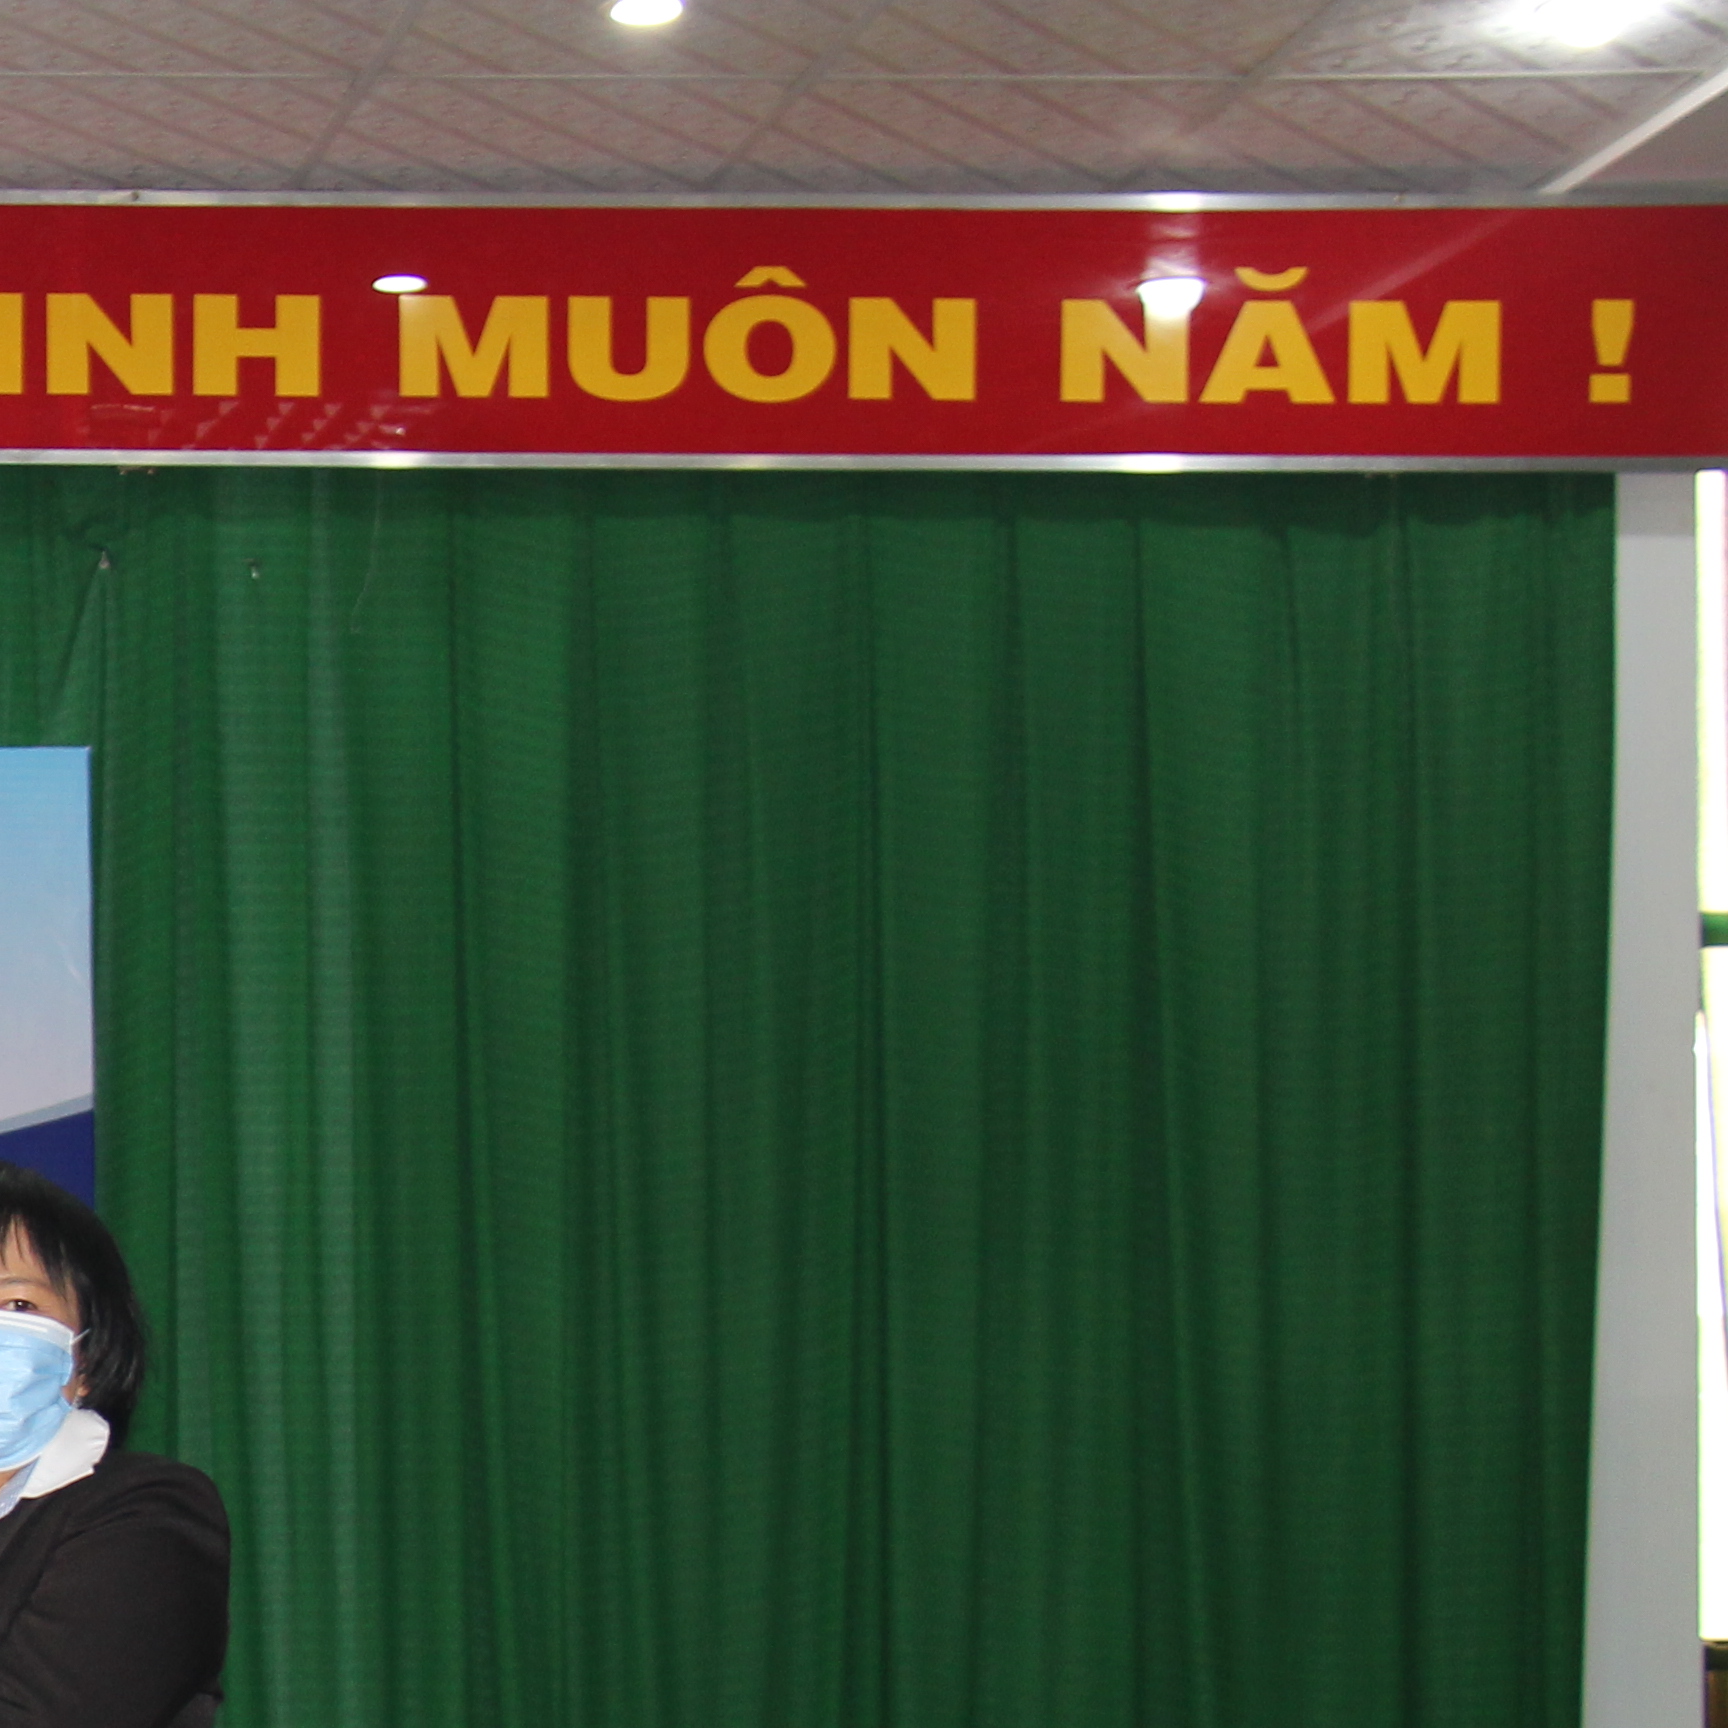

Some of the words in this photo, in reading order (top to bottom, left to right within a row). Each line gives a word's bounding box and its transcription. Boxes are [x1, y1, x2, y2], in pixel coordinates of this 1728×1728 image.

[398, 266, 977, 402] MUÔN
[1060, 266, 1502, 405] NĂM
[1588, 299, 1636, 404] !
